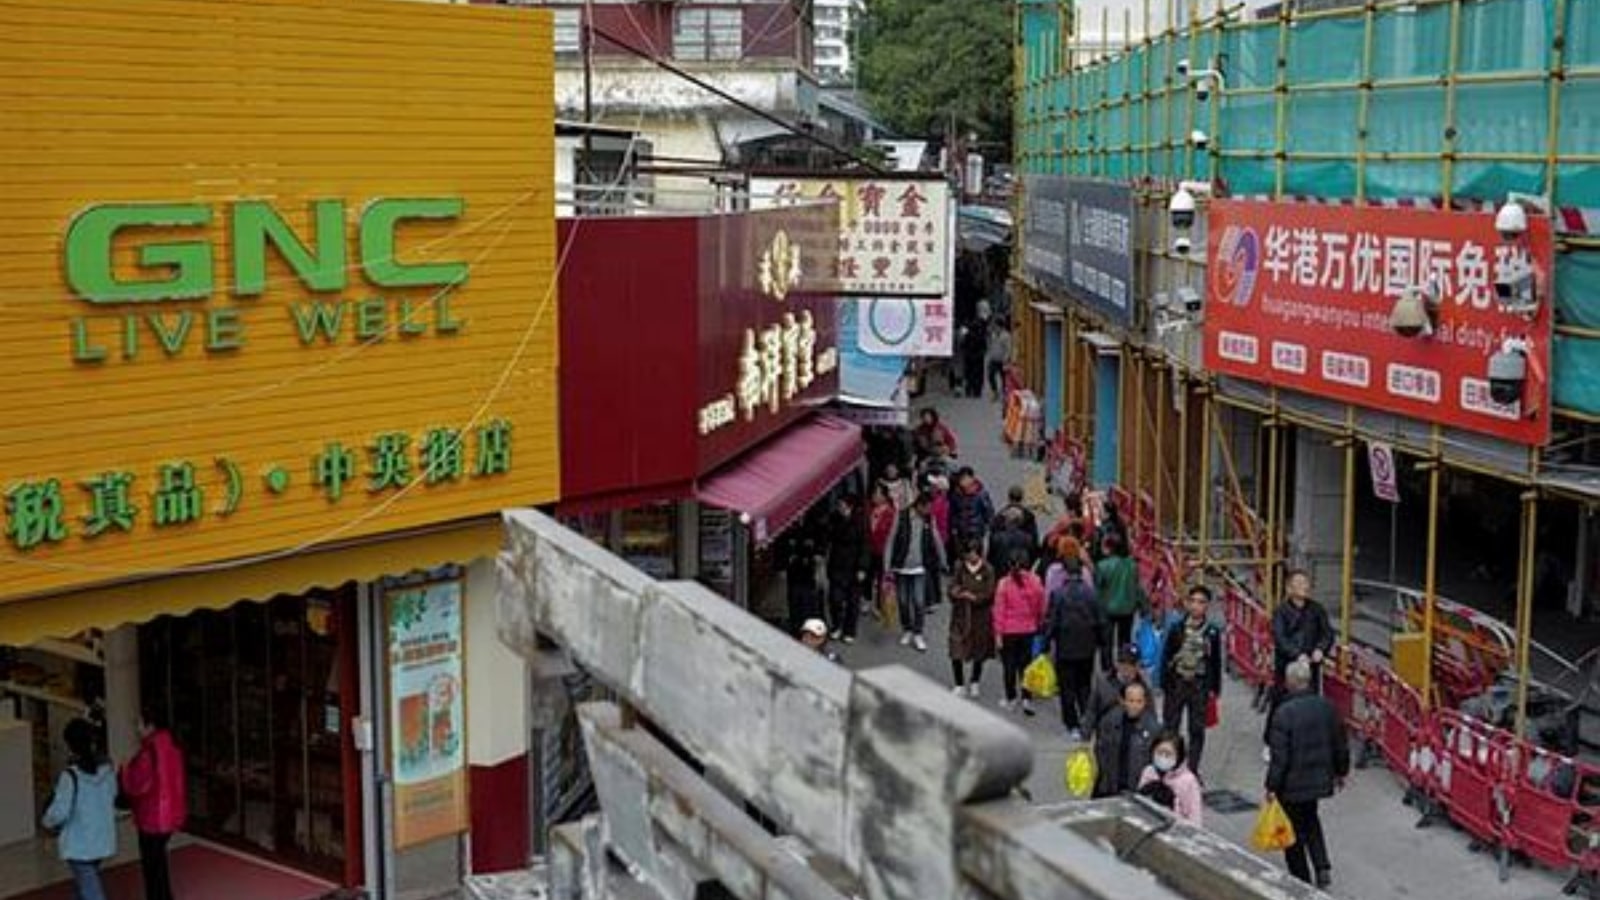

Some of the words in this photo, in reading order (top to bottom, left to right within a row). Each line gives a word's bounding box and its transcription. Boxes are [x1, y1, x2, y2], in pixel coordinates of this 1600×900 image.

[65, 196, 469, 303] GNC
[73, 305, 247, 362] LIVE
[291, 294, 467, 343] WELL
